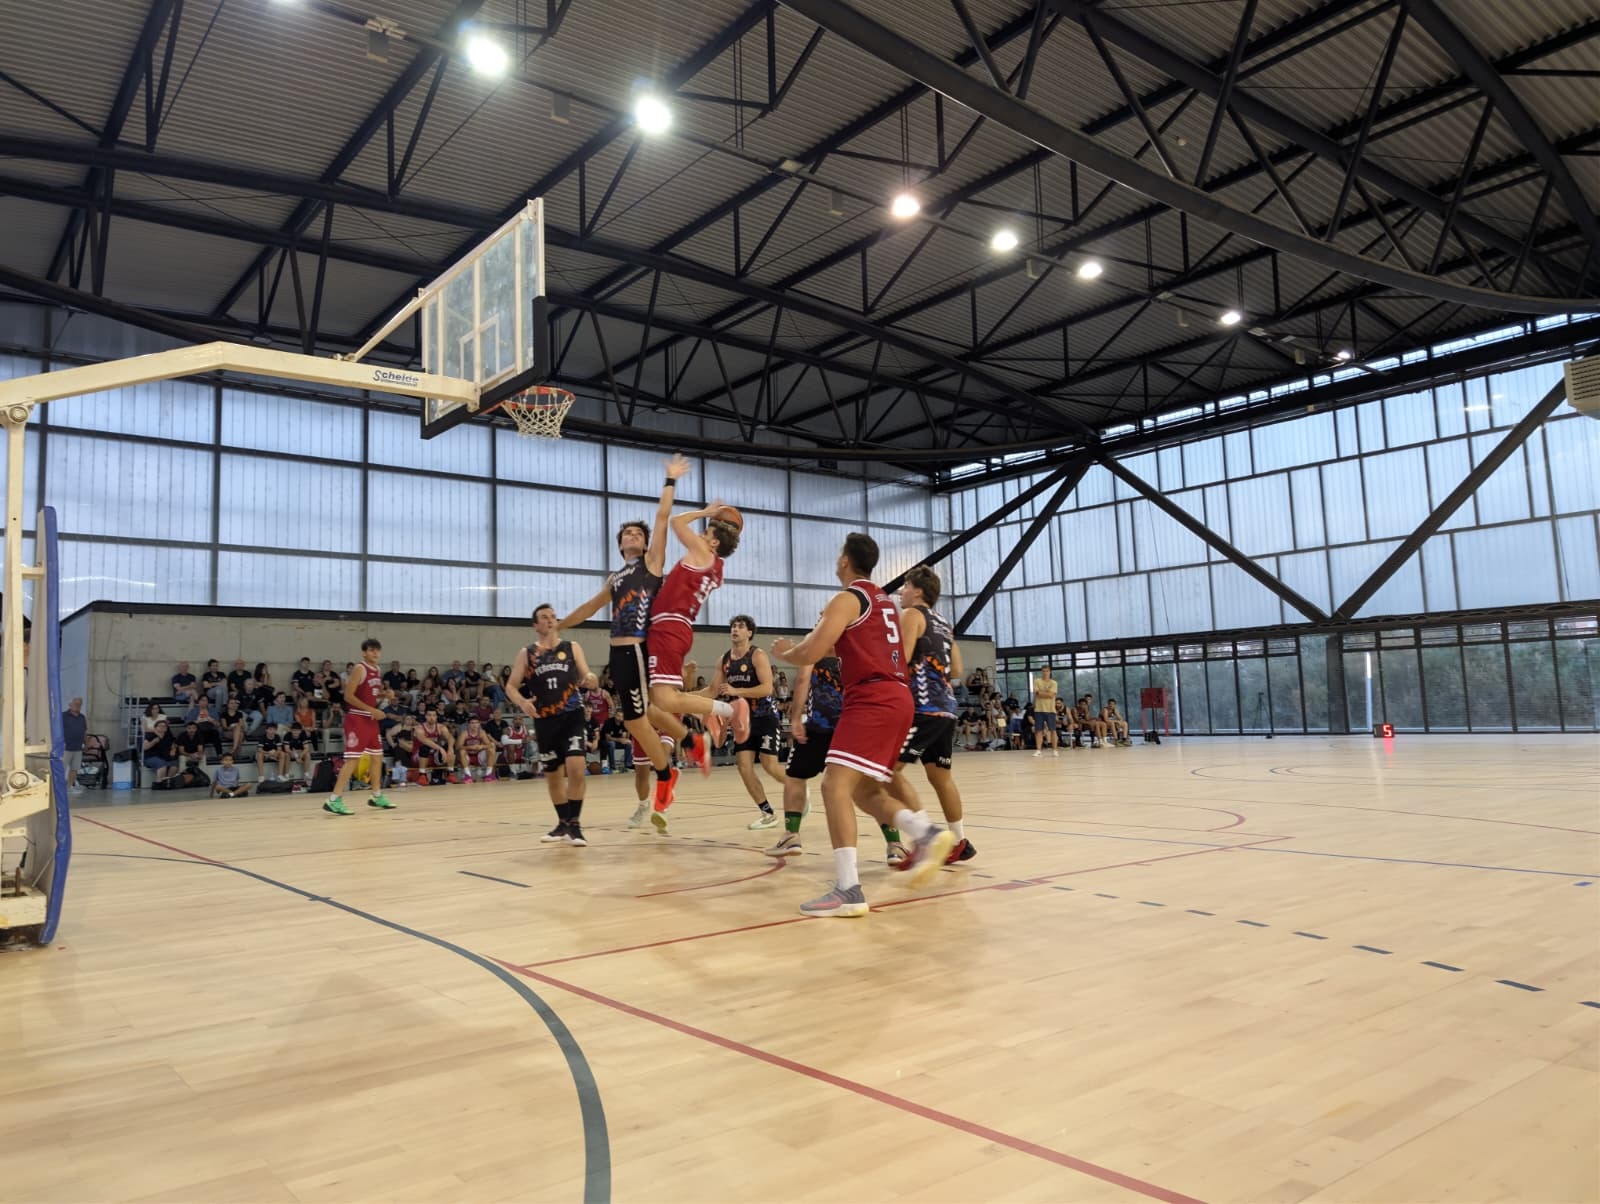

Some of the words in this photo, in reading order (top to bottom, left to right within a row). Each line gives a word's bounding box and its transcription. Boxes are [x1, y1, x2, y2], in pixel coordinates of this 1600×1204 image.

[882, 608, 900, 644] 5
[546, 677, 558, 690] 11
[1383, 724, 1392, 737] 5
